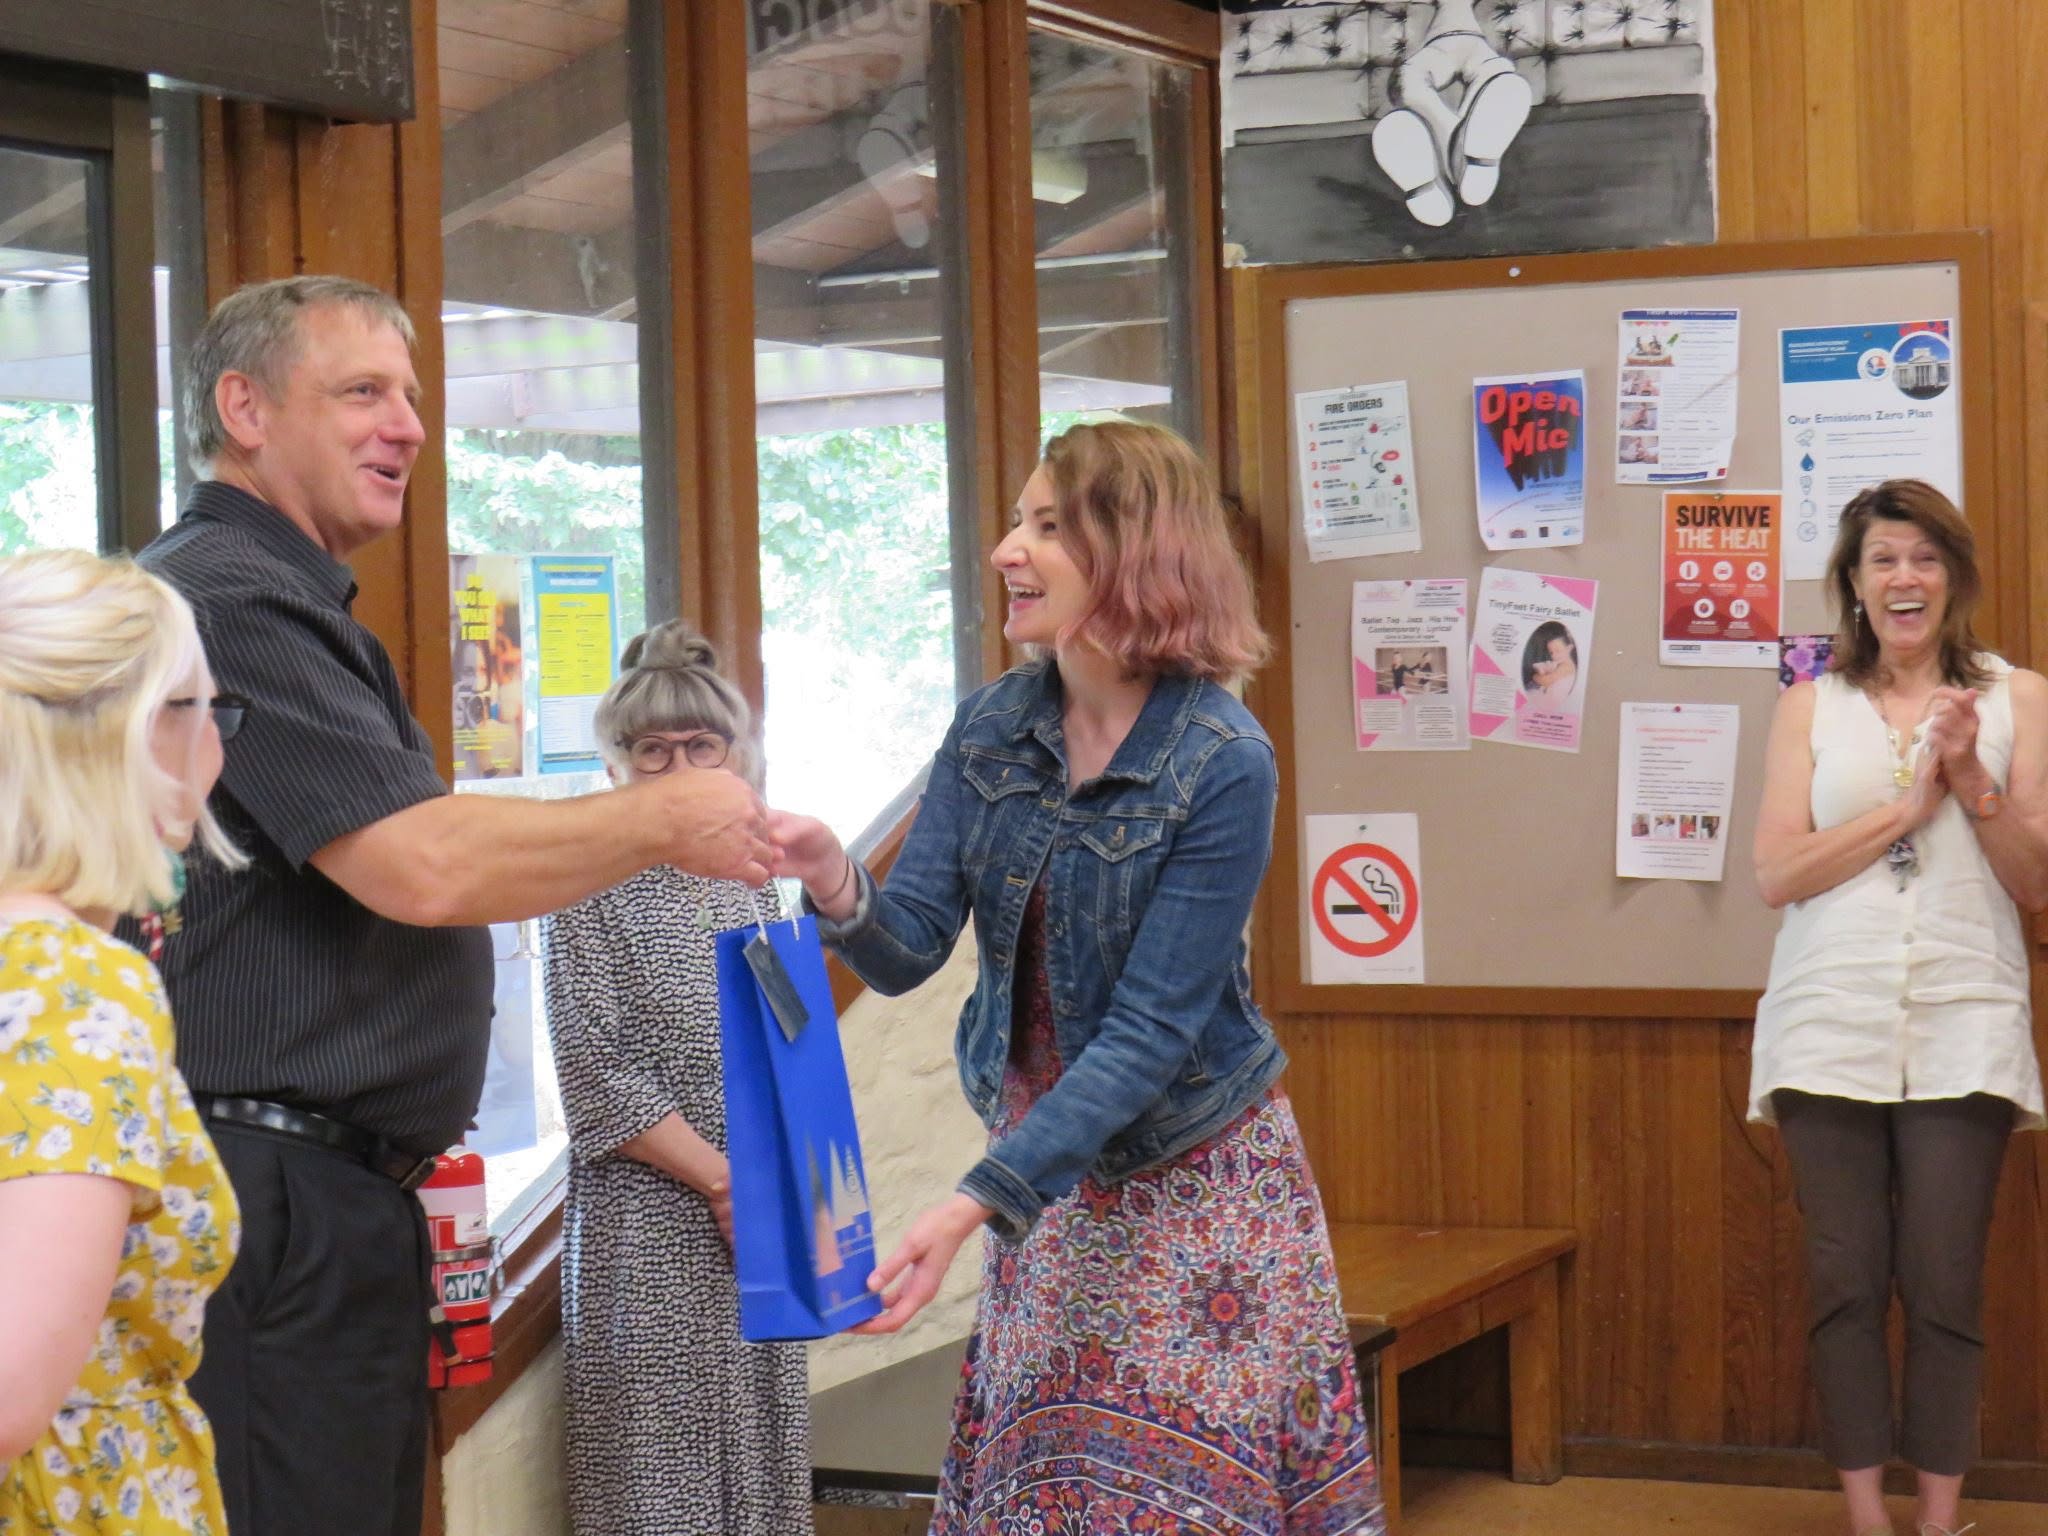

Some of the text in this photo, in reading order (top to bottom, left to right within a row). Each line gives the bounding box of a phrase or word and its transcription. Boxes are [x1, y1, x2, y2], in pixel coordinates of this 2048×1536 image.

[1324, 398, 1383, 414] FIRE ORDERS
[1481, 386, 1581, 426] Open
[1788, 409, 1933, 424] Our Emissions Zero Plan
[1309, 442, 1317, 451] 2
[1503, 418, 1569, 468] Mic
[1676, 505, 1770, 528] SURVIVE
[1675, 528, 1771, 549] THE HEAT
[1530, 603, 1553, 616] Fairy
[1555, 607, 1581, 617] Ballet
